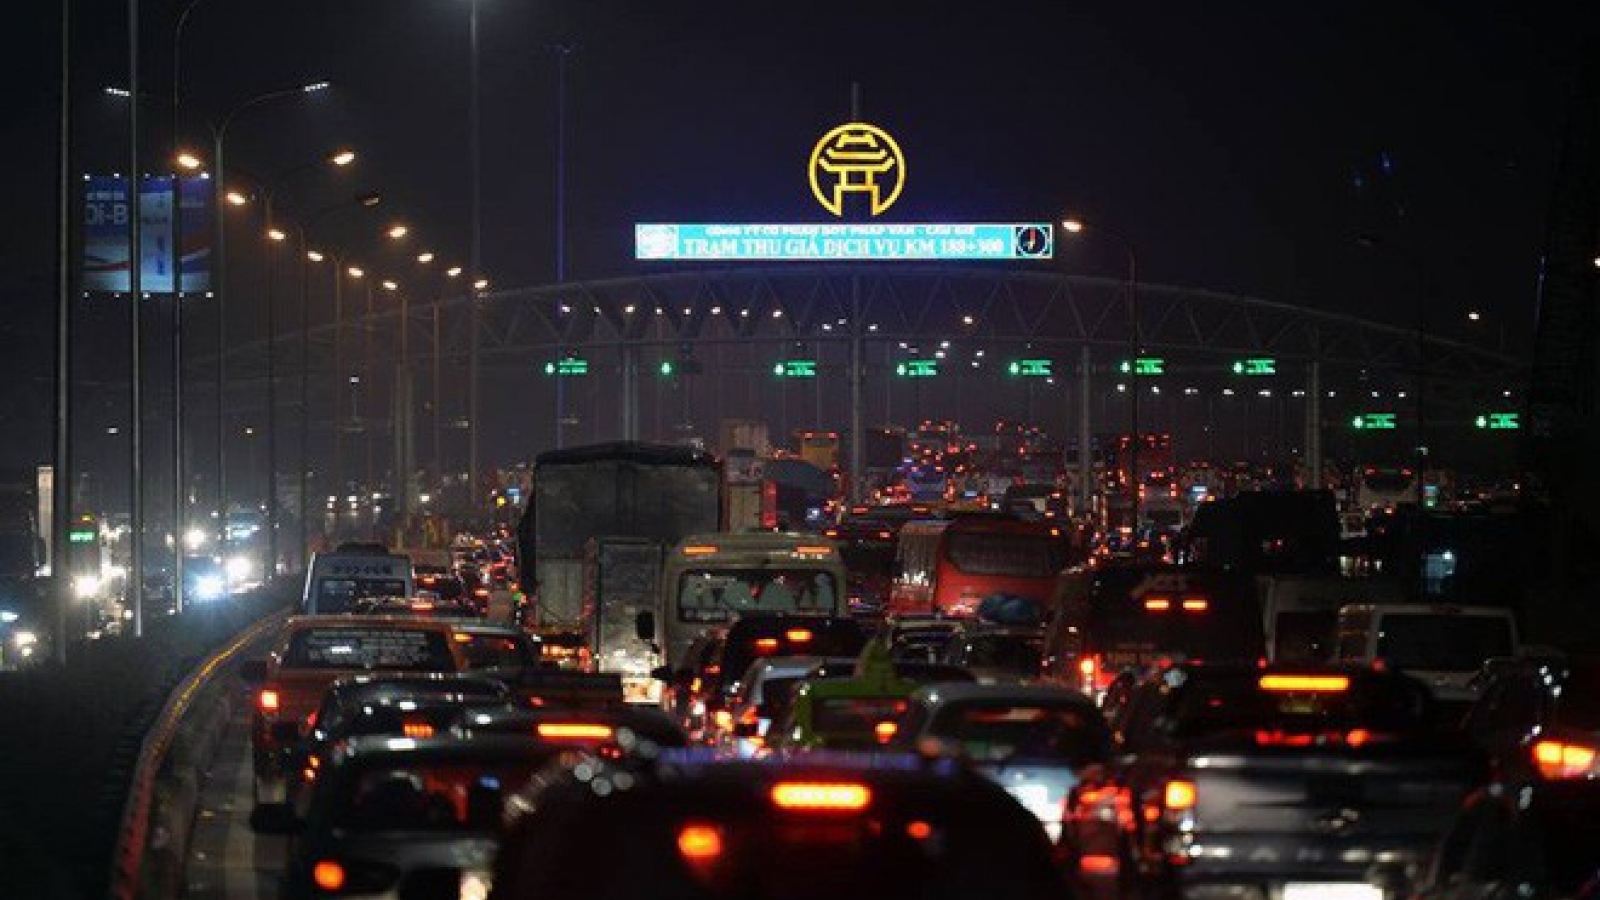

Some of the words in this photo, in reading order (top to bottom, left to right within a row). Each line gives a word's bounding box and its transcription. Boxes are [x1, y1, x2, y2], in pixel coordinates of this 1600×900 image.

[684, 238, 738, 257] TRẠM
[742, 238, 781, 255] THU
[824, 238, 868, 257] DỊCH
[870, 238, 900, 257] VỤ
[906, 238, 934, 255] KM
